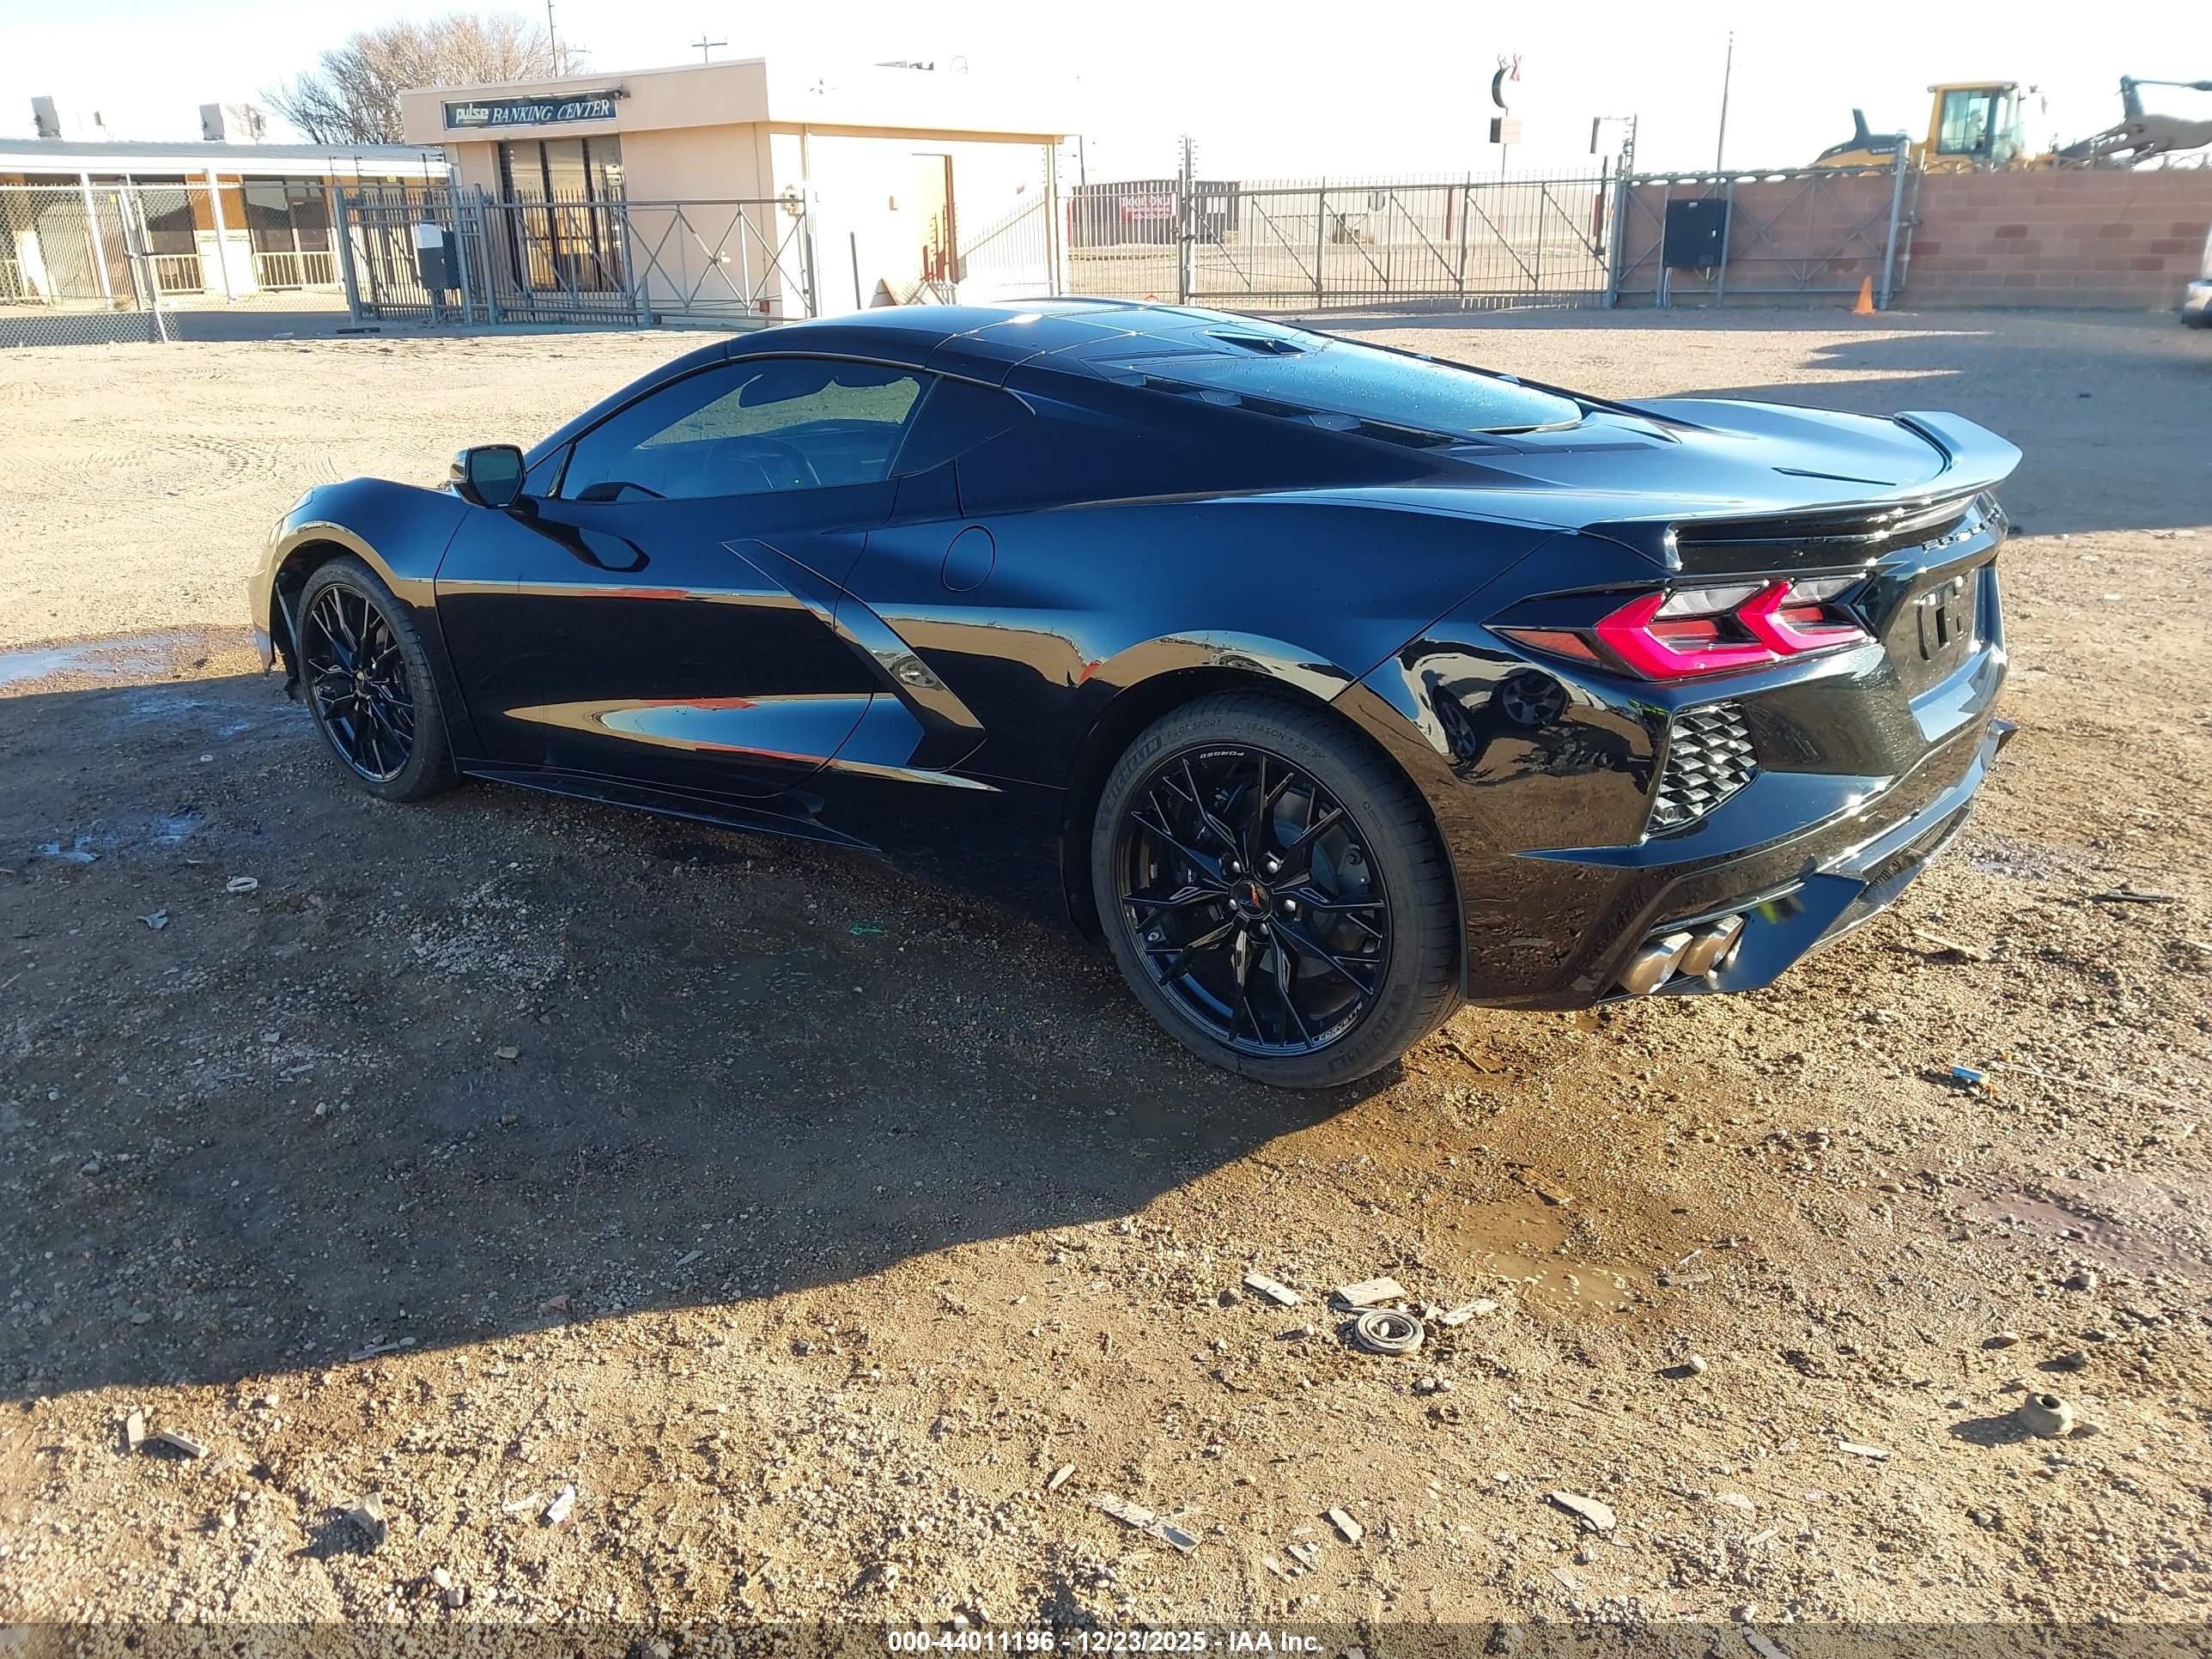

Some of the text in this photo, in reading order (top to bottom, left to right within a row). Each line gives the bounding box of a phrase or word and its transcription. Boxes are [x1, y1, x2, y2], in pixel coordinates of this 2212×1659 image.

[455, 99, 610, 124] pulse BANKING CENTER
[1193, 720, 1222, 729] SPORT
[1200, 750, 1245, 759] FORGED
[1319, 1001, 1363, 1042] CORVETTE
